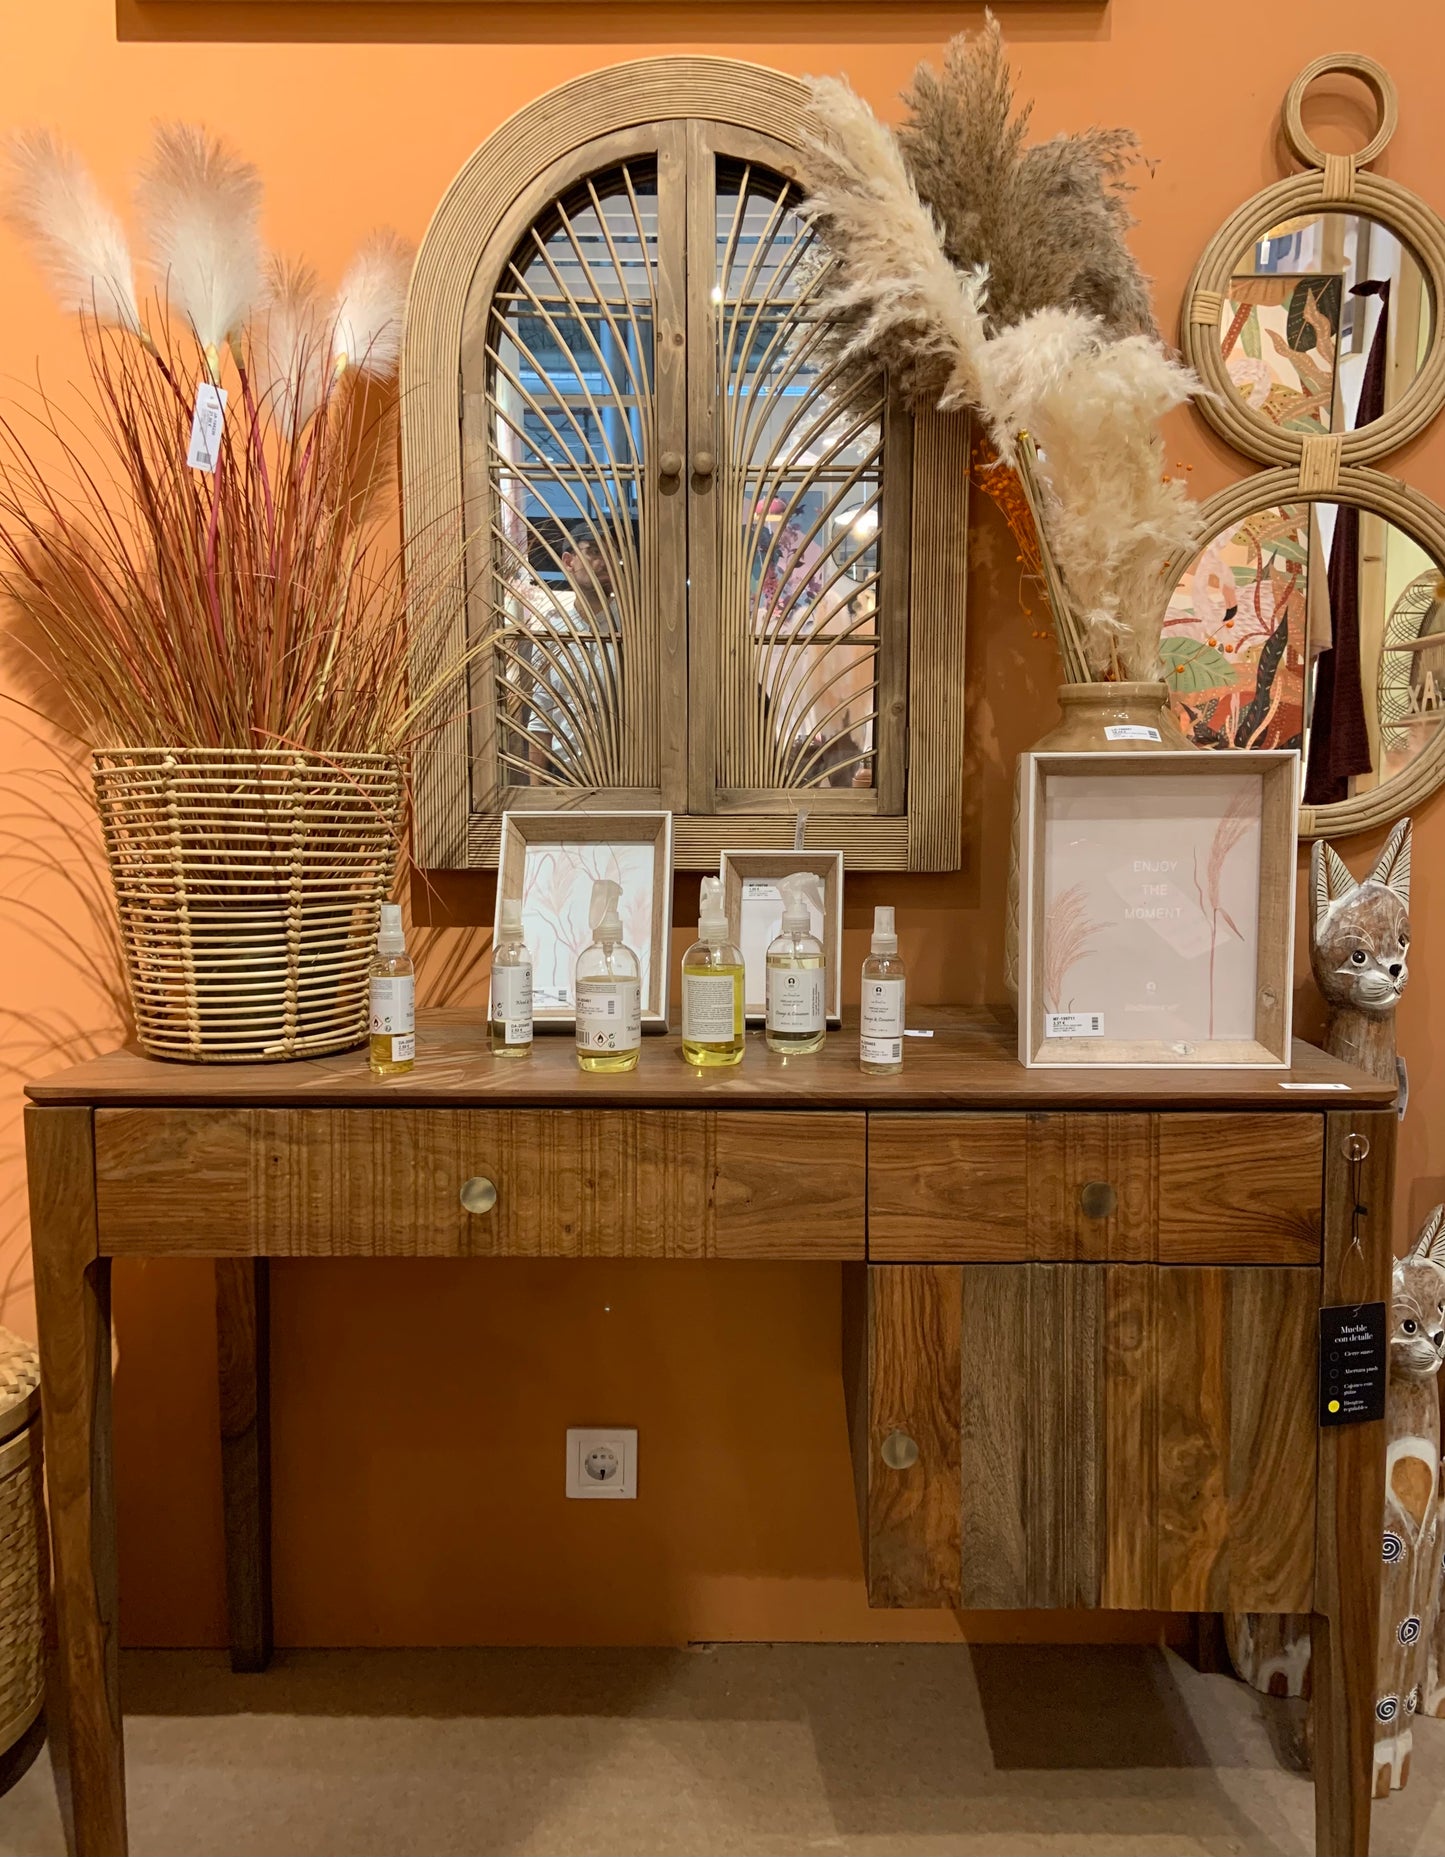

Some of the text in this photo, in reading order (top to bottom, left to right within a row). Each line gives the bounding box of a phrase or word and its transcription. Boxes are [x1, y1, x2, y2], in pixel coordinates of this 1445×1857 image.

[1133, 860, 1178, 873] ENJOY
[1140, 884, 1168, 896] THE
[1124, 907, 1183, 920] MOMENT
[1341, 1324, 1368, 1334] Mueble
[1349, 1332, 1373, 1342] detalle
